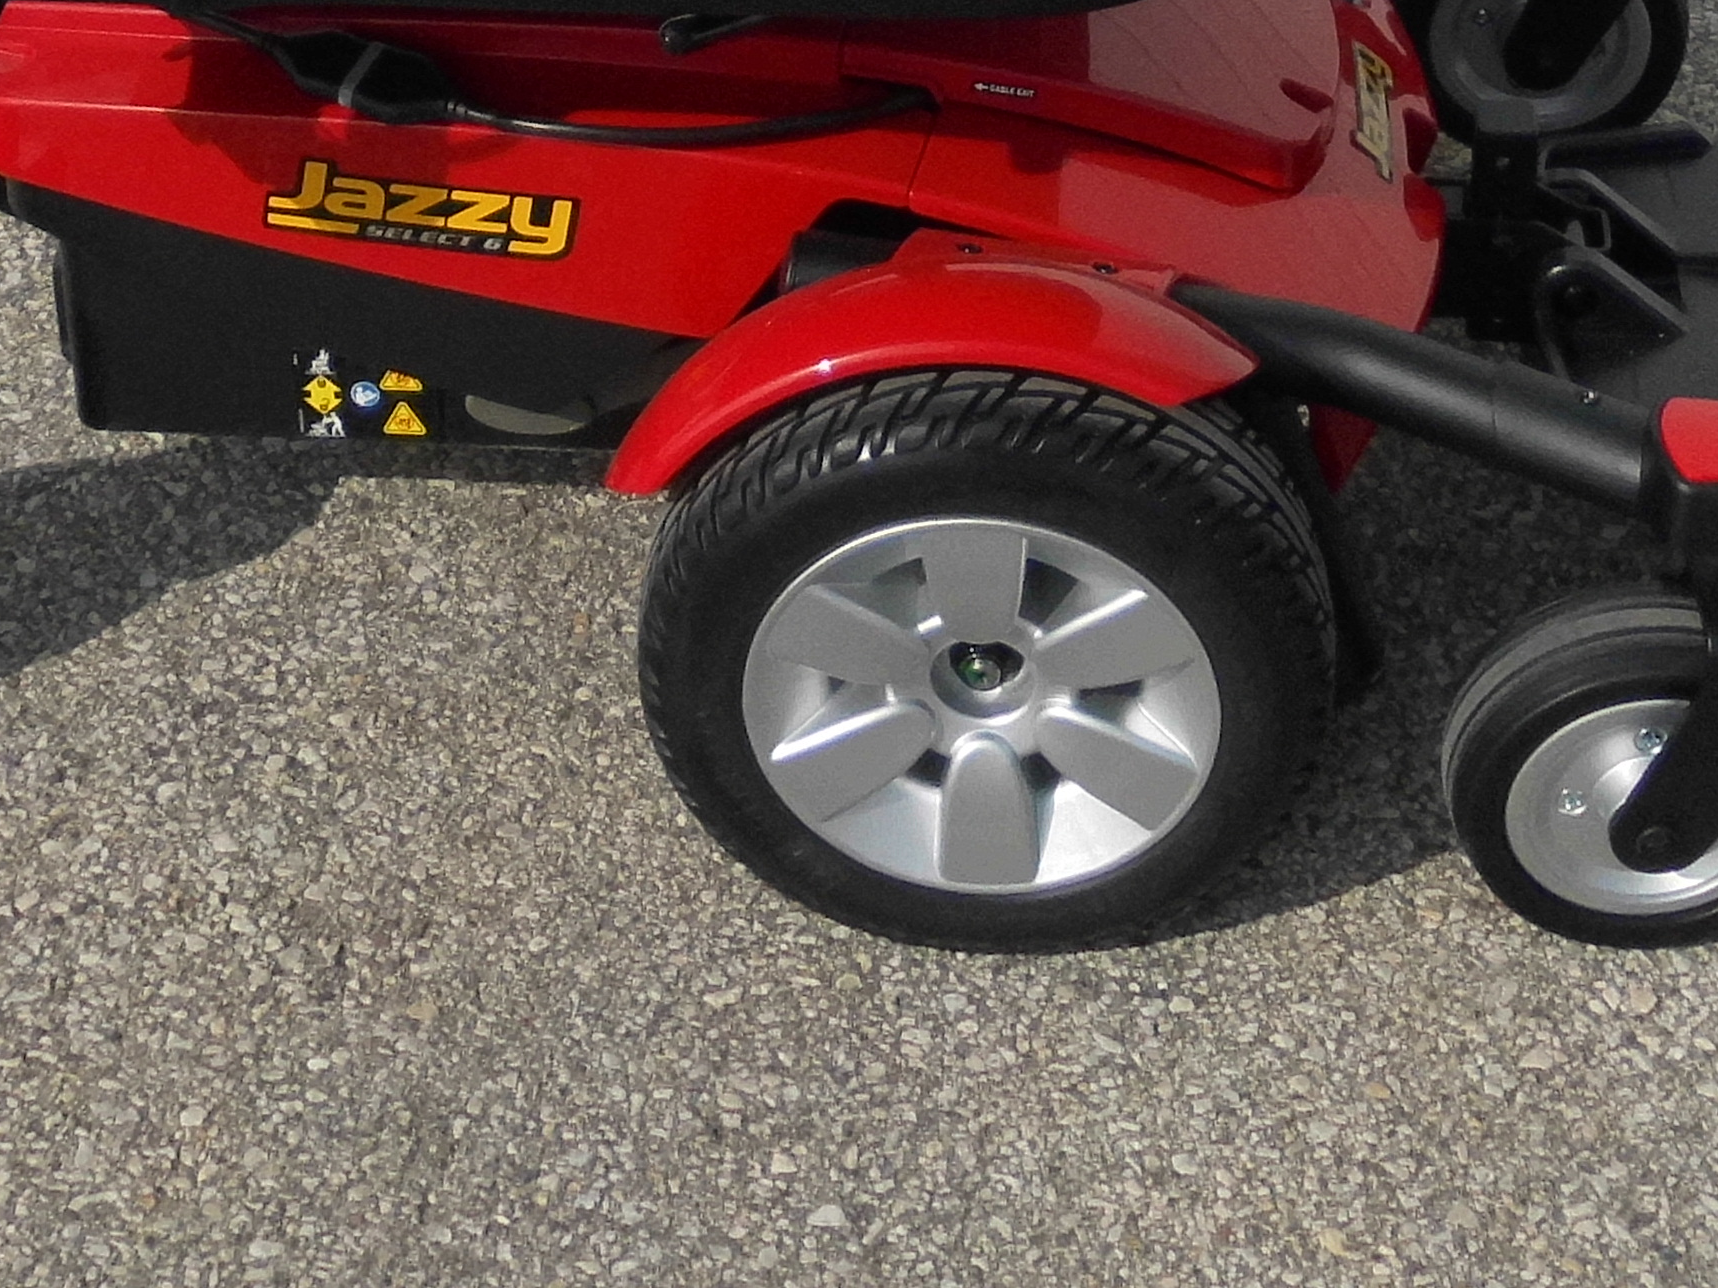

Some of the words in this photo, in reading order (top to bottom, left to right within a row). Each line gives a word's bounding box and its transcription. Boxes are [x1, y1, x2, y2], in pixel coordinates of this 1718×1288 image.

[268, 161, 572, 255] Jazzy
[366, 225, 473, 247] SELECT
[483, 238, 503, 251] 6
